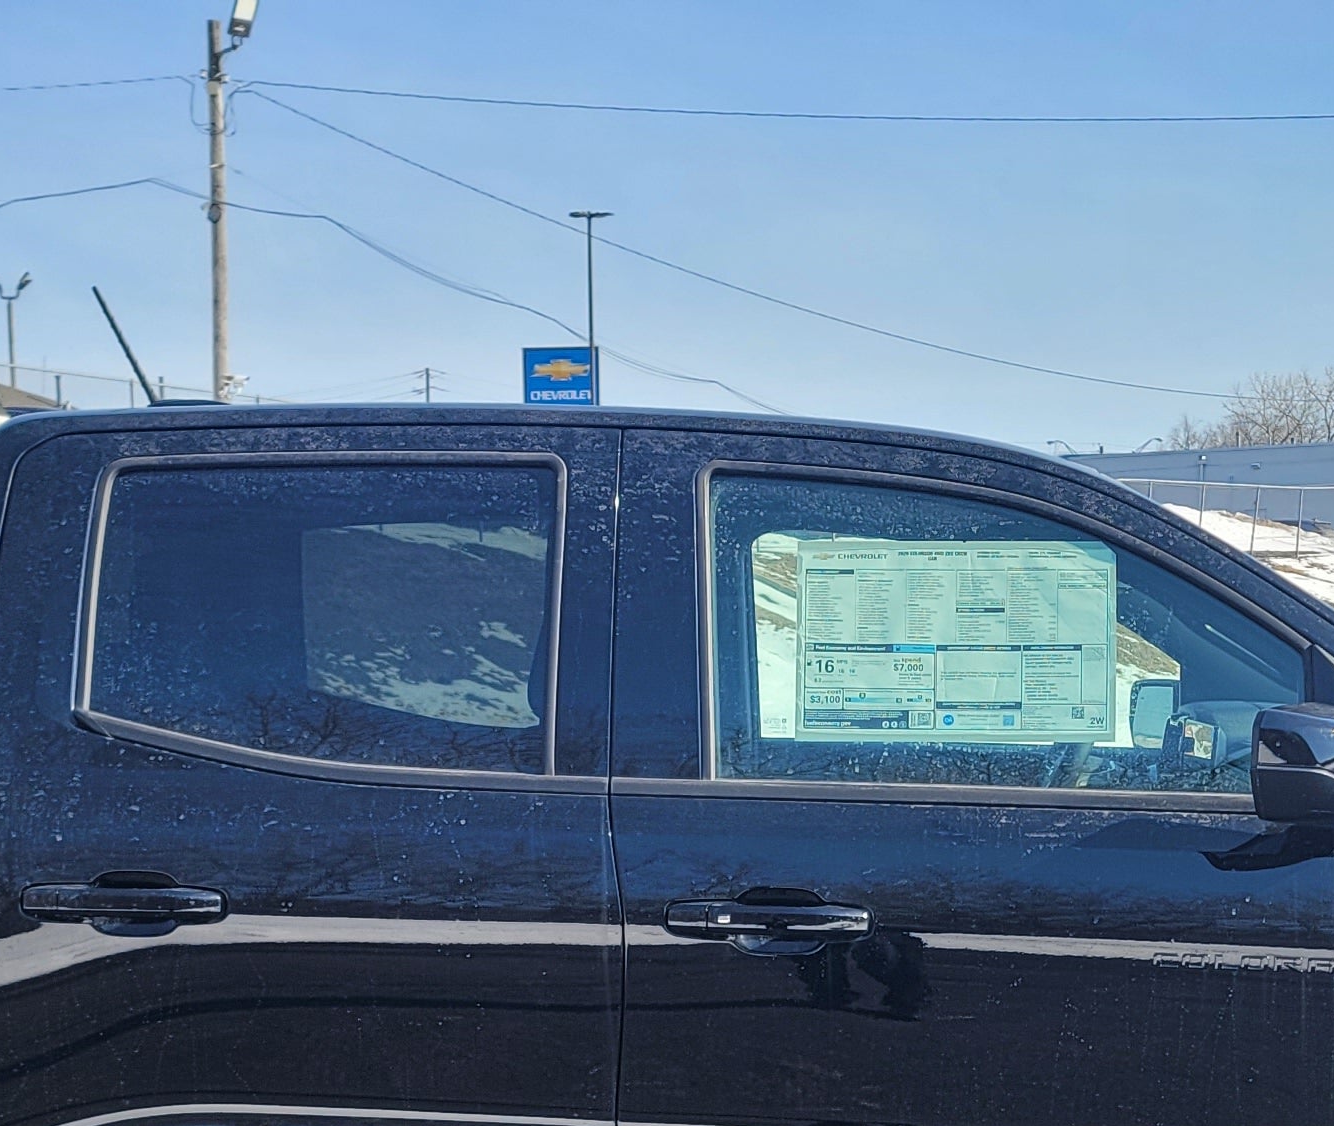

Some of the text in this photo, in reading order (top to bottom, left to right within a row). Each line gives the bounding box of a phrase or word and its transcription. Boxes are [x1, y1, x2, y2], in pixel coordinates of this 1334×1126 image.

[815, 659, 835, 673] 16
[893, 663, 924, 672] $7,000
[810, 695, 841, 704] $3,100
[1090, 716, 1105, 725] 2W
